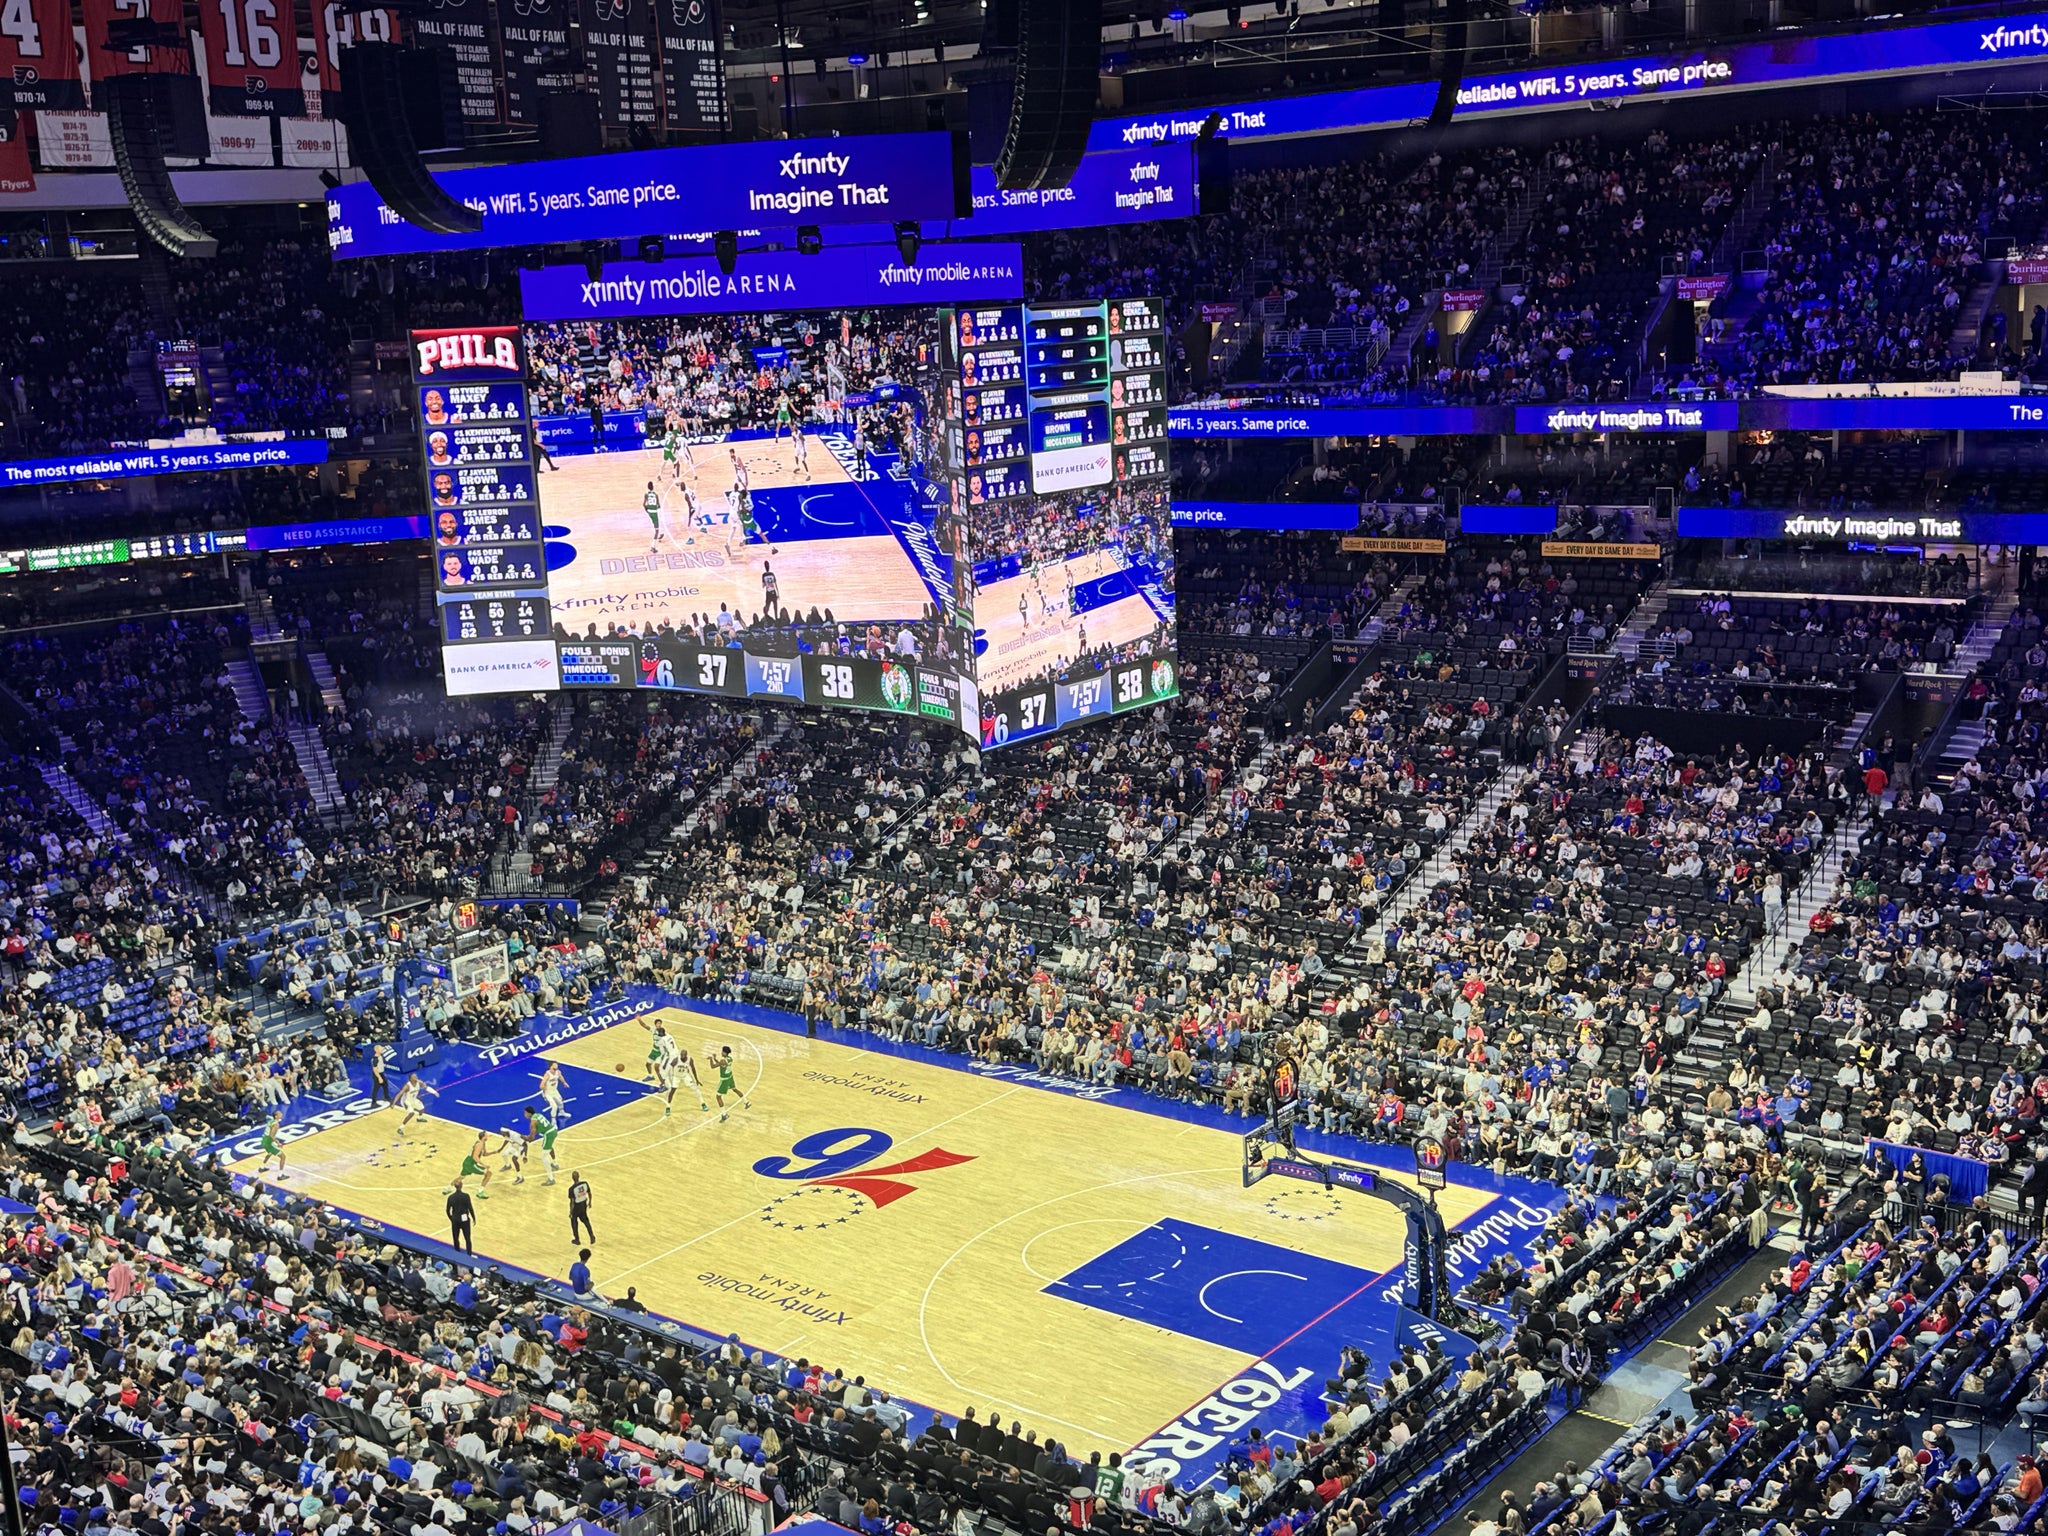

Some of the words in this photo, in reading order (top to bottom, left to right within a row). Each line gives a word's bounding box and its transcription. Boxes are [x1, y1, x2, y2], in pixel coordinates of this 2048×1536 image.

[219, 0, 282, 67] 16
[418, 20, 442, 35] HALL
[444, 23, 456, 36] OF
[458, 24, 485, 38] FAME
[506, 27, 528, 40] HALL
[529, 29, 541, 42] OF
[588, 32, 608, 45] HALL
[610, 33, 621, 46] OF
[665, 37, 684, 50] HALL
[686, 39, 696, 51] OF
[1520, 74, 1561, 98] WiFi.
[1564, 75, 1575, 93] 5
[1579, 70, 1628, 96] years.
[1633, 65, 1680, 87] Same
[1683, 59, 1732, 84] price.
[14, 92, 46, 103] 1970-74
[62, 122, 87, 131] 1974-75
[1122, 120, 1168, 144] xfinity
[1233, 111, 1266, 129] That
[220, 137, 256, 149] 1996-97
[297, 140, 331, 151] 2009-10
[779, 151, 850, 179] xfinity
[1130, 161, 1159, 183] xfinity
[1, 180, 30, 190] Flyers
[490, 192, 526, 216] WiFi.
[529, 191, 538, 211] 5
[542, 191, 585, 217] years.
[588, 185, 629, 207] Same
[633, 179, 680, 208] price.
[749, 186, 833, 214] Imagine
[838, 182, 889, 206] That
[1001, 190, 1038, 206] Same
[1041, 187, 1076, 208] price.
[1115, 187, 1153, 211] Imagine
[1154, 183, 1173, 204] That
[377, 205, 399, 225] The
[879, 264, 923, 286] xfinity
[926, 262, 970, 282] mobile
[973, 266, 1013, 280] ARENA
[581, 274, 645, 308] xfinity
[650, 270, 721, 298] mobile
[725, 272, 796, 295] ARENA
[417, 334, 519, 375] PHILA
[1062, 349, 1074, 358] AST
[1062, 371, 1075, 380] BLK
[450, 393, 487, 404] MAXEY
[1065, 393, 1088, 403] LEADERS
[1054, 409, 1087, 421] 3-POINTERS
[1547, 410, 1598, 430] xfinity
[1600, 410, 1663, 432] Imagine
[1666, 408, 1703, 426] That
[2010, 405, 2043, 421] The
[1045, 423, 1071, 434] BROWN
[1197, 417, 1204, 430] 5
[1205, 418, 1241, 435] years.
[1242, 416, 1273, 430] Same
[1276, 416, 1310, 434] price.
[455, 434, 522, 444] CALDWELL-POPE
[983, 436, 1004, 445] JAMES
[6, 467, 31, 481] The
[34, 465, 67, 478] most
[69, 460, 123, 476] reliable
[124, 455, 158, 469] WiFi.
[161, 456, 169, 467] 5
[171, 455, 212, 473] years.
[214, 452, 251, 465] Same
[253, 448, 290, 467] price.
[1036, 470, 1054, 478] BANK
[1056, 467, 1064, 475] OF
[1065, 463, 1095, 474] AMERICA
[459, 475, 498, 485] BROWN
[986, 475, 1004, 484] WADE
[478, 508, 509, 516] LEBRON
[1194, 507, 1227, 523] price.
[463, 516, 498, 525] JAMES
[1784, 516, 1842, 537] xfinity
[1844, 517, 1916, 540] Imagine
[1918, 517, 1961, 537] That
[283, 529, 311, 542] NEED
[314, 524, 383, 539] ASSISTANCE?
[1363, 541, 1378, 550] EVERY
[1379, 541, 1389, 550] DAY
[1390, 541, 1396, 550] IS
[1397, 541, 1411, 550] GAME
[1412, 541, 1423, 550] DAY
[1566, 545, 1582, 554] EVERY
[1585, 545, 1596, 555] DAY
[1597, 545, 1603, 555] IS
[1605, 545, 1621, 555] GAME
[1623, 546, 1634, 555] DAY
[468, 556, 499, 565] WADE
[494, 590, 516, 598] STATS
[550, 593, 629, 612] xfinity
[635, 586, 700, 601] mobile
[489, 608, 505, 619] 50
[518, 606, 533, 617] 14
[598, 601, 669, 615] ARENA
[461, 628, 477, 638] 82
[561, 646, 592, 656] FOULS
[600, 646, 630, 656] BONUS
[451, 666, 476, 674] BANK
[492, 662, 532, 671] AMERICA
[562, 665, 608, 674] TIMEOUTS
[697, 653, 727, 687] 37
[759, 660, 791, 684] 7:57
[821, 664, 854, 699] 38
[919, 672, 939, 685] FOULS
[1118, 668, 1142, 703] 38
[1925, 680, 1942, 690] Rock
[767, 680, 784, 693] 2ND
[1069, 679, 1102, 709] 7:57
[920, 693, 949, 708] TIMEOUTS
[1906, 691, 1917, 700] 112
[1020, 694, 1047, 730] 37
[1814, 752, 1824, 760] 73
[478, 999, 654, 1066] Philadelphia
[802, 1070, 866, 1090] mobile
[852, 1071, 911, 1088] ARENA
[863, 1085, 929, 1104] xfinity
[197, 1098, 391, 1166] 76ERS
[1338, 1170, 1363, 1185] xfinity
[1405, 1240, 1418, 1290] xfinity
[697, 1271, 775, 1300] mobile
[759, 1274, 831, 1299] ARENA
[770, 1296, 853, 1326] xfinity
[1118, 1360, 1314, 1480] 76ERS
[1095, 1476, 1114, 1498] 12
[1160, 1511, 1176, 1523] 33
